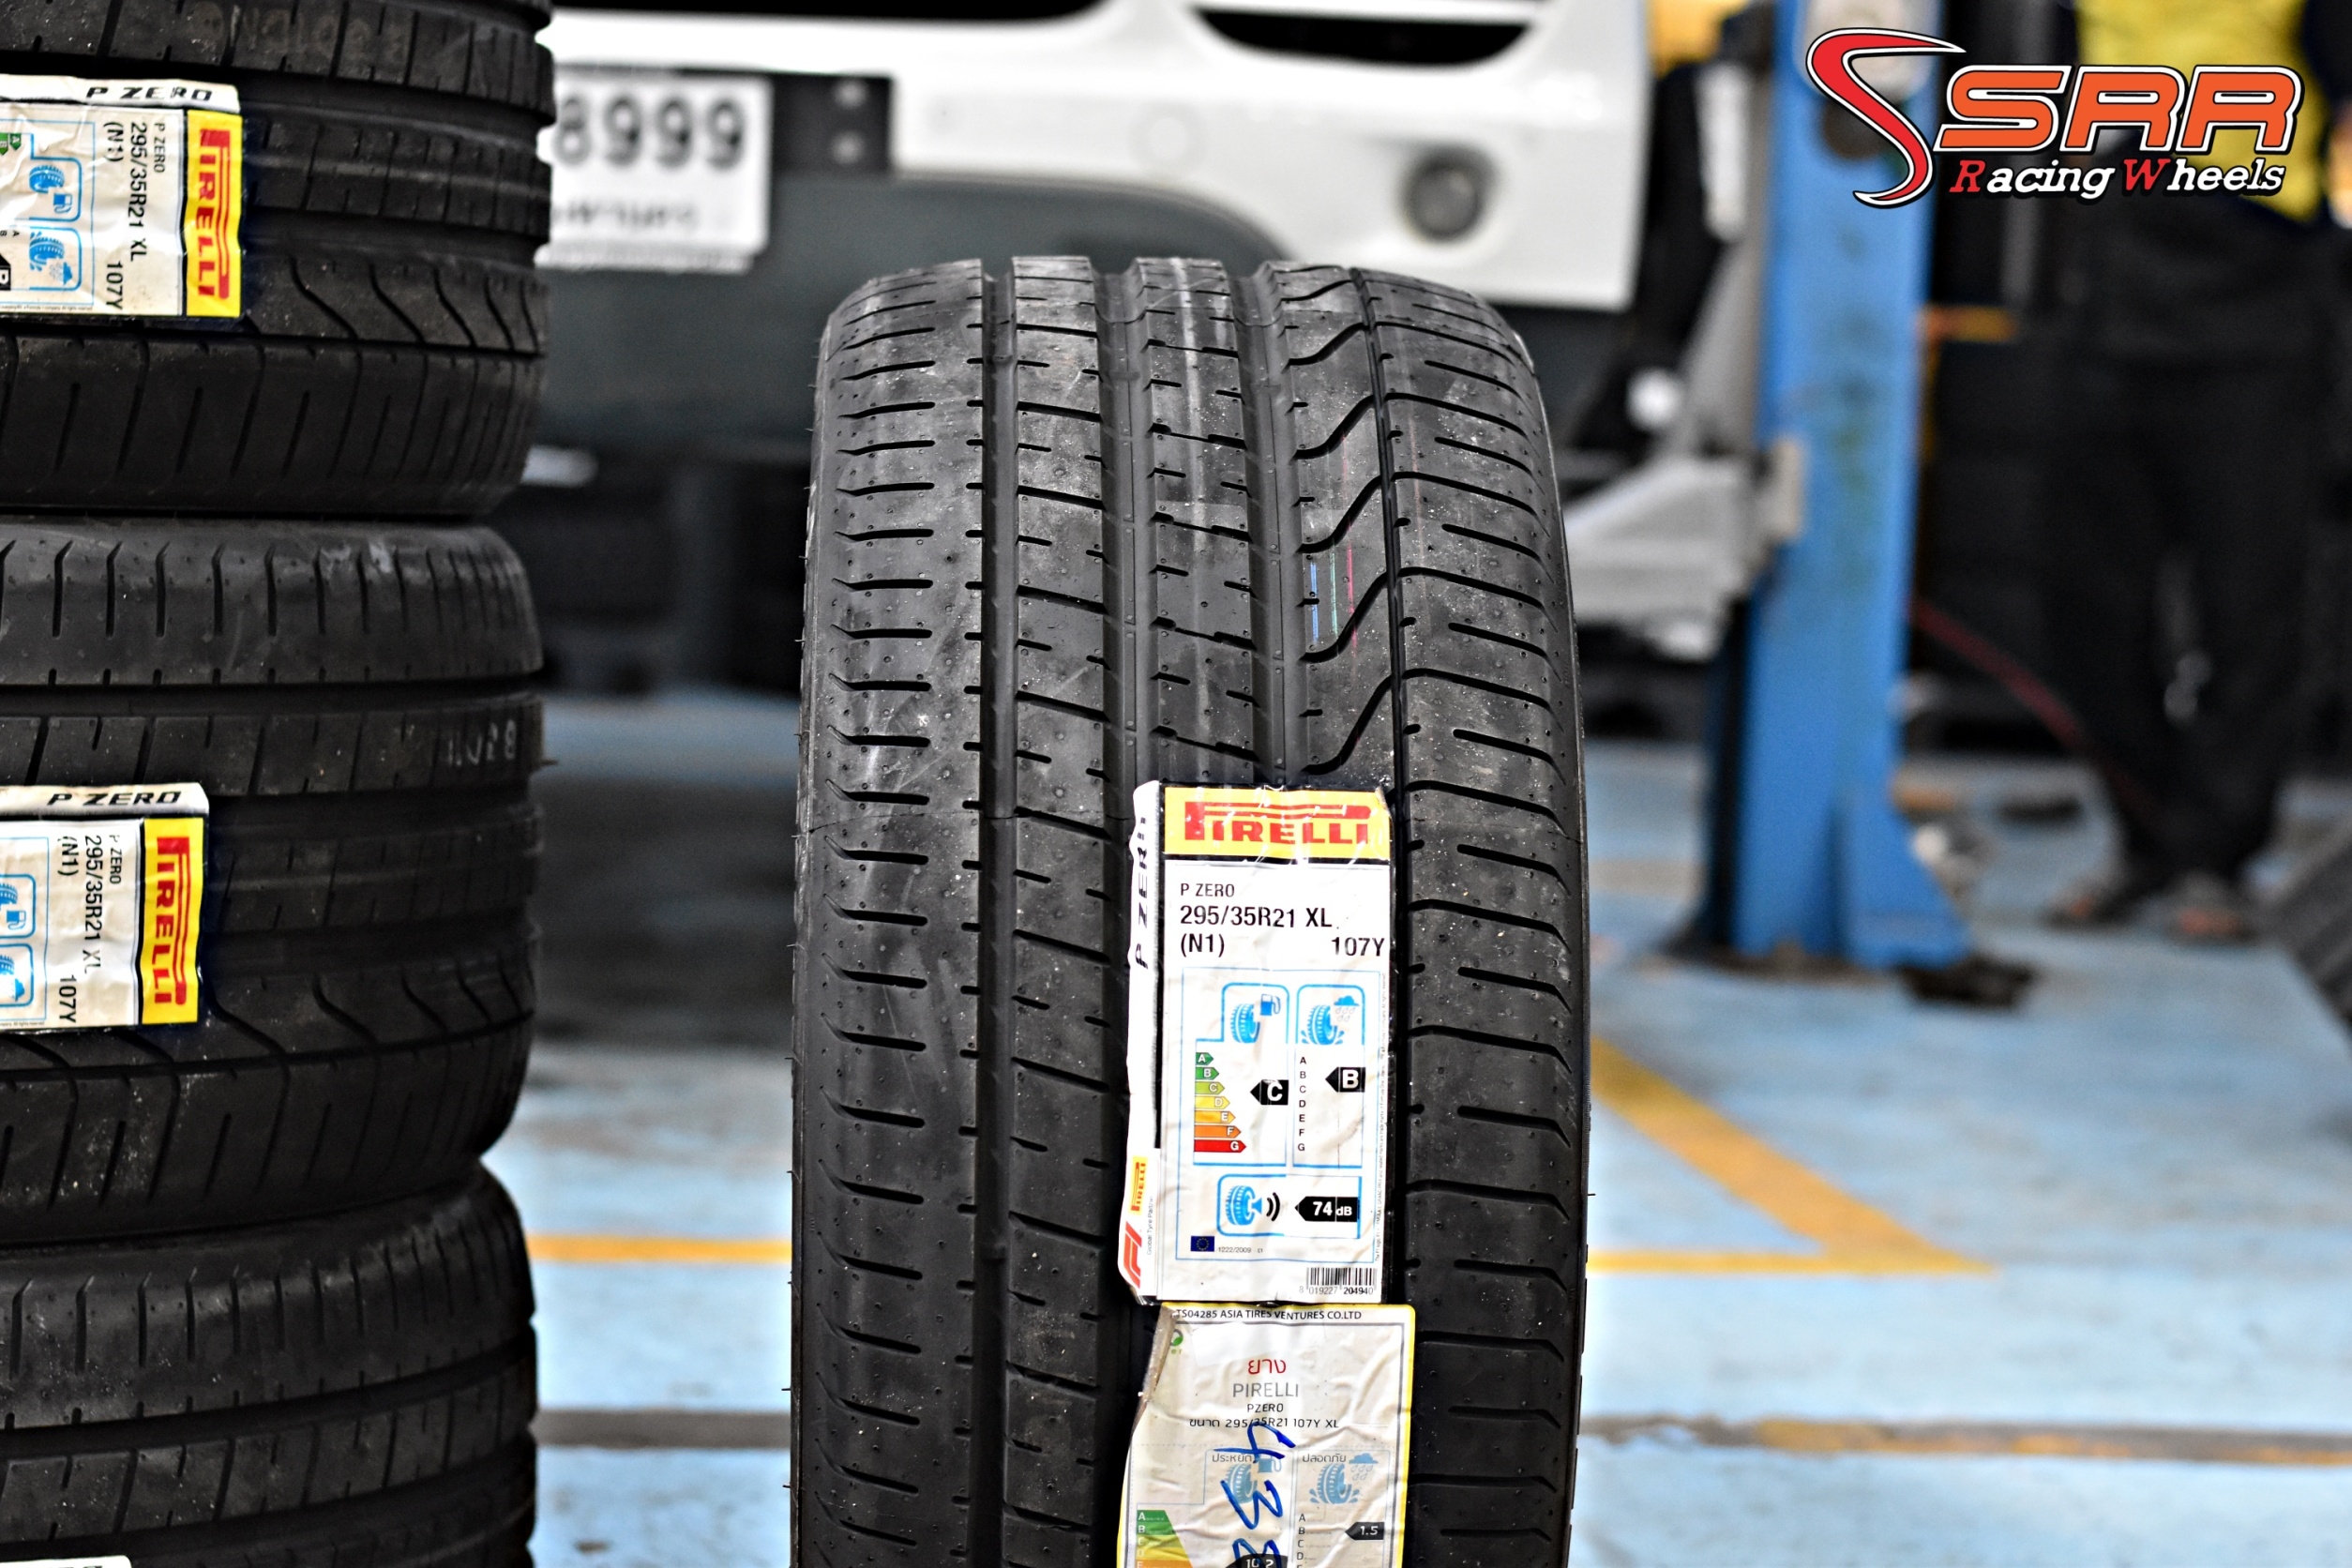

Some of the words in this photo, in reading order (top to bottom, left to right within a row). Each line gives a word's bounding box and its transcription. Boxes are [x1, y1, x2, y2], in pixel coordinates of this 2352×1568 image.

[85, 86, 109, 98] P
[120, 87, 213, 100] ZERO
[154, 123, 165, 131] P
[103, 121, 124, 162] (N1)
[154, 136, 165, 173] ZERO
[128, 122, 147, 228] 295/35R21
[195, 128, 231, 300] PIRELLI
[130, 238, 147, 262] XL
[106, 262, 124, 310] 107Y
[47, 793, 73, 806] P
[83, 791, 182, 806] ZERO
[1184, 801, 1371, 845] PIRELLI
[57, 836, 79, 877] (N1)
[110, 849, 122, 884] ZERO
[84, 835, 103, 942] 295/35R21
[1180, 883, 1189, 897] P
[1196, 883, 1235, 897] ZERO
[152, 837, 190, 1005] PIRELLI
[1180, 905, 1294, 928] 295/35R21
[1305, 908, 1333, 927] XL
[1181, 933, 1226, 957] (N1)
[1331, 938, 1385, 957] 107Y
[83, 949, 101, 973] XL
[1135, 943, 1149, 970] P
[59, 974, 77, 1023] 107Y
[1198, 1054, 1207, 1063] A
[1203, 1068, 1212, 1078] B
[1342, 1069, 1359, 1089] B
[1209, 1083, 1217, 1093] C
[1267, 1080, 1283, 1102] C
[1299, 1085, 1306, 1093] C
[1214, 1098, 1223, 1107] D
[1221, 1112, 1229, 1122] E
[1299, 1114, 1305, 1123] E
[1227, 1127, 1234, 1136] F
[1230, 1142, 1239, 1151] G
[1131, 1162, 1146, 1212] PIRELLI
[1313, 1201, 1333, 1216] 74
[1335, 1205, 1352, 1216] dB
[1218, 1246, 1252, 1255] 1222/2009
[1308, 1286, 1338, 1295] 019227
[1343, 1287, 1374, 1295] 204940
[1220, 1310, 1243, 1319] ASIA
[1245, 1310, 1272, 1319] TIRES
[1274, 1310, 1324, 1320] VENTURES
[1327, 1311, 1362, 1319] CO.LTD
[1248, 1359, 1287, 1375] ยาง
[1232, 1382, 1299, 1397] PIRELLI
[1247, 1403, 1284, 1413] PZERO
[1189, 1418, 1220, 1427] ขนาด
[1293, 1418, 1320, 1428] 107Y
[1325, 1419, 1339, 1428] XL
[1302, 1453, 1347, 1463] ปลอดภัย
[1138, 1512, 1146, 1521] A
[1299, 1514, 1306, 1522] A
[1299, 1527, 1305, 1535] B
[1360, 1526, 1378, 1535] 1.5
[1297, 1552, 1304, 1560] D
